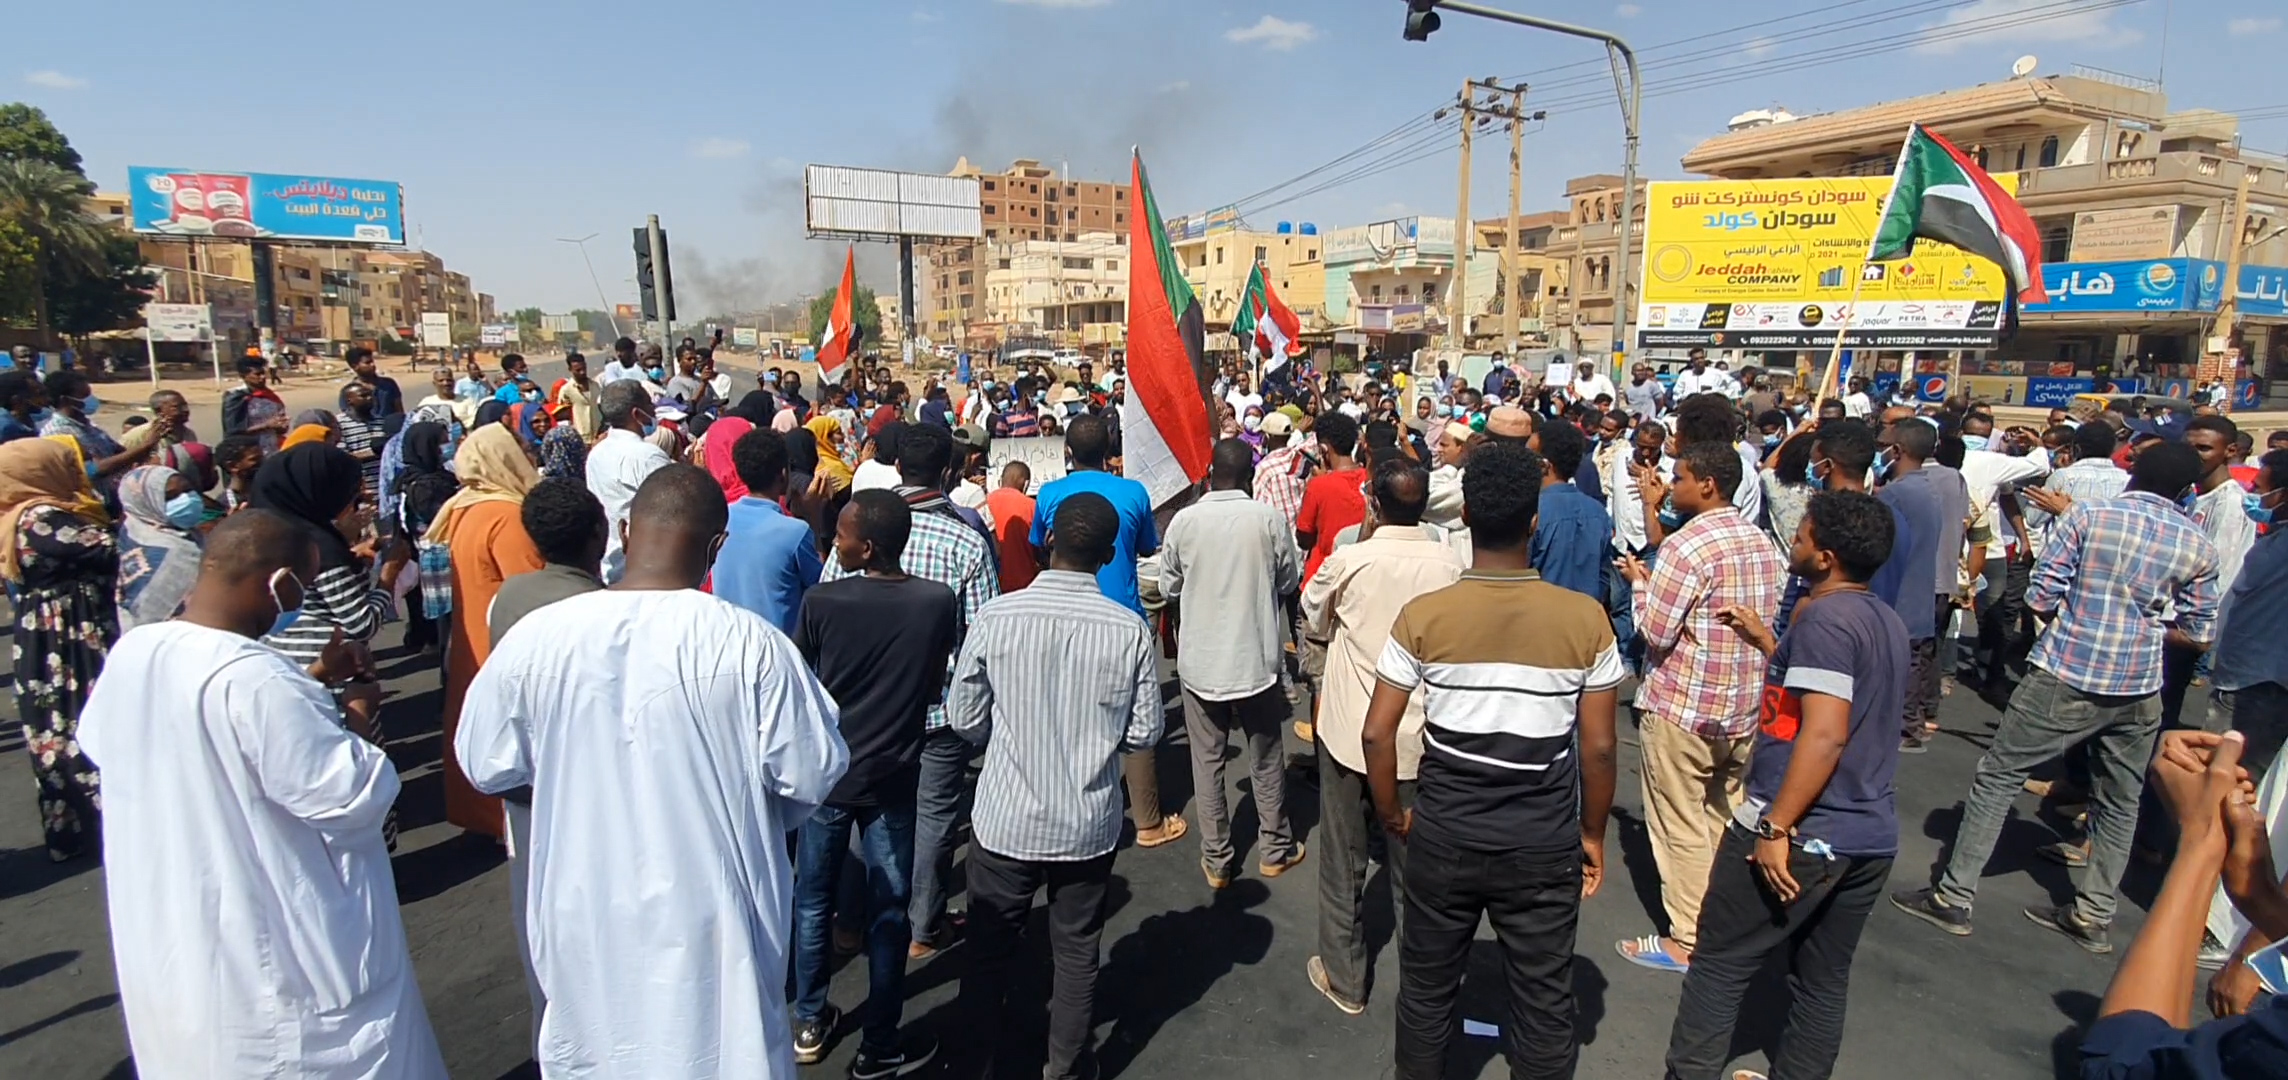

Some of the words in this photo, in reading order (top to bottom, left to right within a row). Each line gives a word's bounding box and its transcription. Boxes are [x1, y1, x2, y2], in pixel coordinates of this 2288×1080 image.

[352, 188, 387, 202] تحلية
[1703, 190, 1803, 207] كونستركت
[1807, 190, 1866, 205] سودان
[285, 202, 319, 216] البيت
[322, 203, 361, 217] قعدة
[1702, 211, 1758, 231] كولد
[1762, 210, 1836, 230] سودان
[1723, 245, 1767, 259] الرئيسي
[1769, 244, 1800, 257] الراعي
[1695, 263, 1767, 276] Jeddah
[1726, 275, 1801, 285] COMPANY
